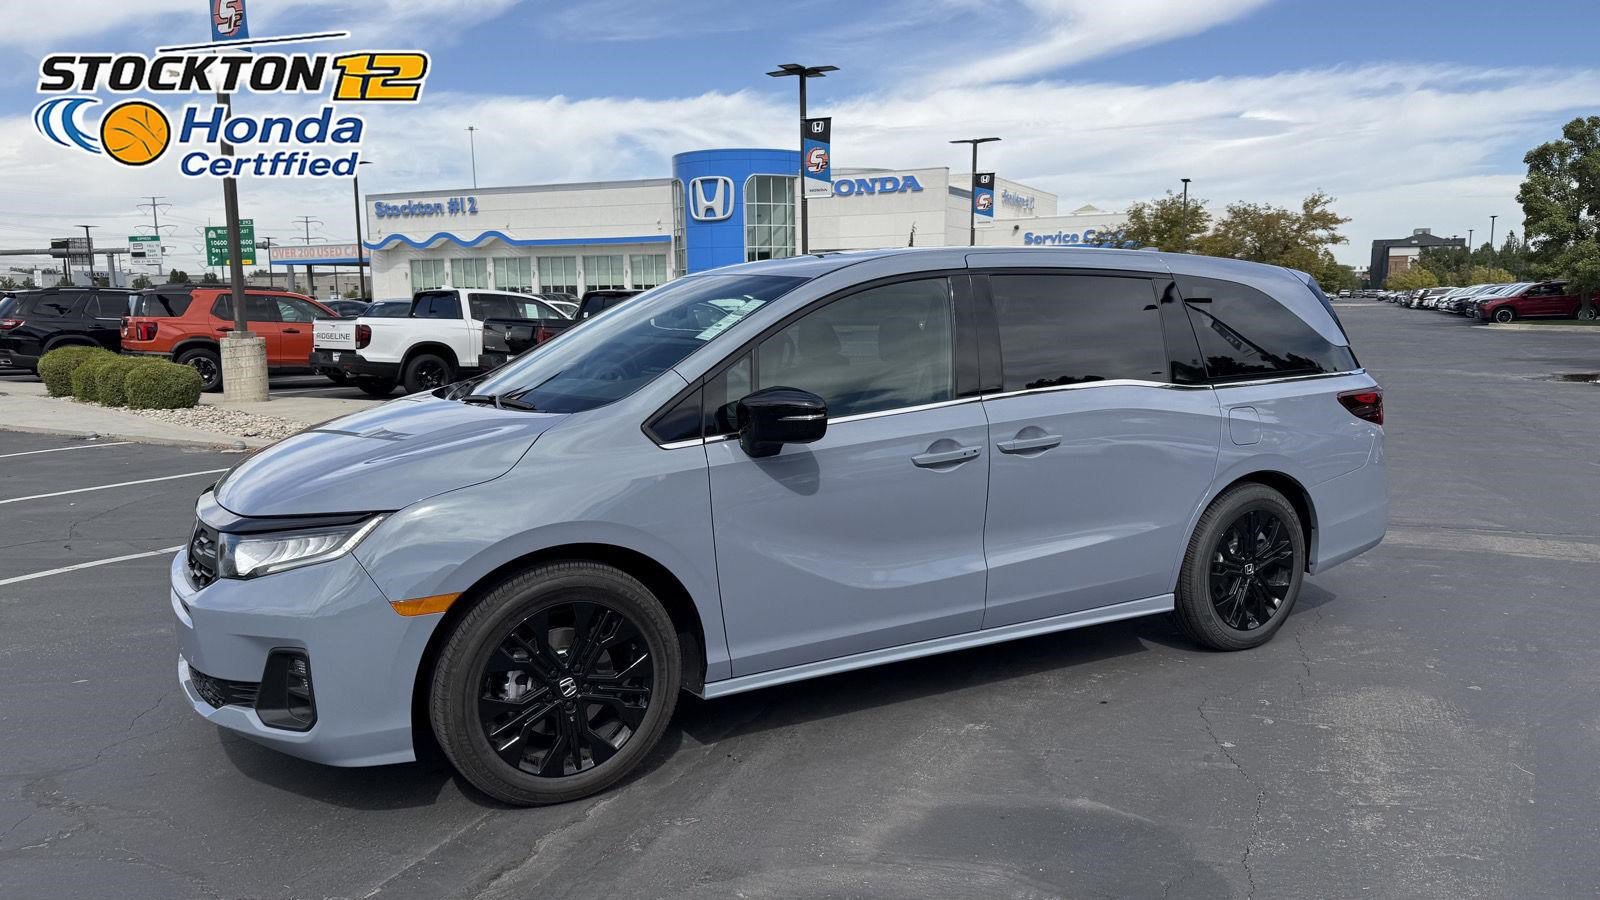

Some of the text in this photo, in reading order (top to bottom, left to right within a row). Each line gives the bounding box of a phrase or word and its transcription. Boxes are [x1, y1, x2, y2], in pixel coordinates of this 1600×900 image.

[831, 176, 923, 197] ONDA
[375, 197, 478, 218] Stockton #12
[1024, 231, 1080, 245] Service
[271, 248, 297, 259] OVER
[299, 247, 316, 258] 200
[319, 246, 343, 257] USED
